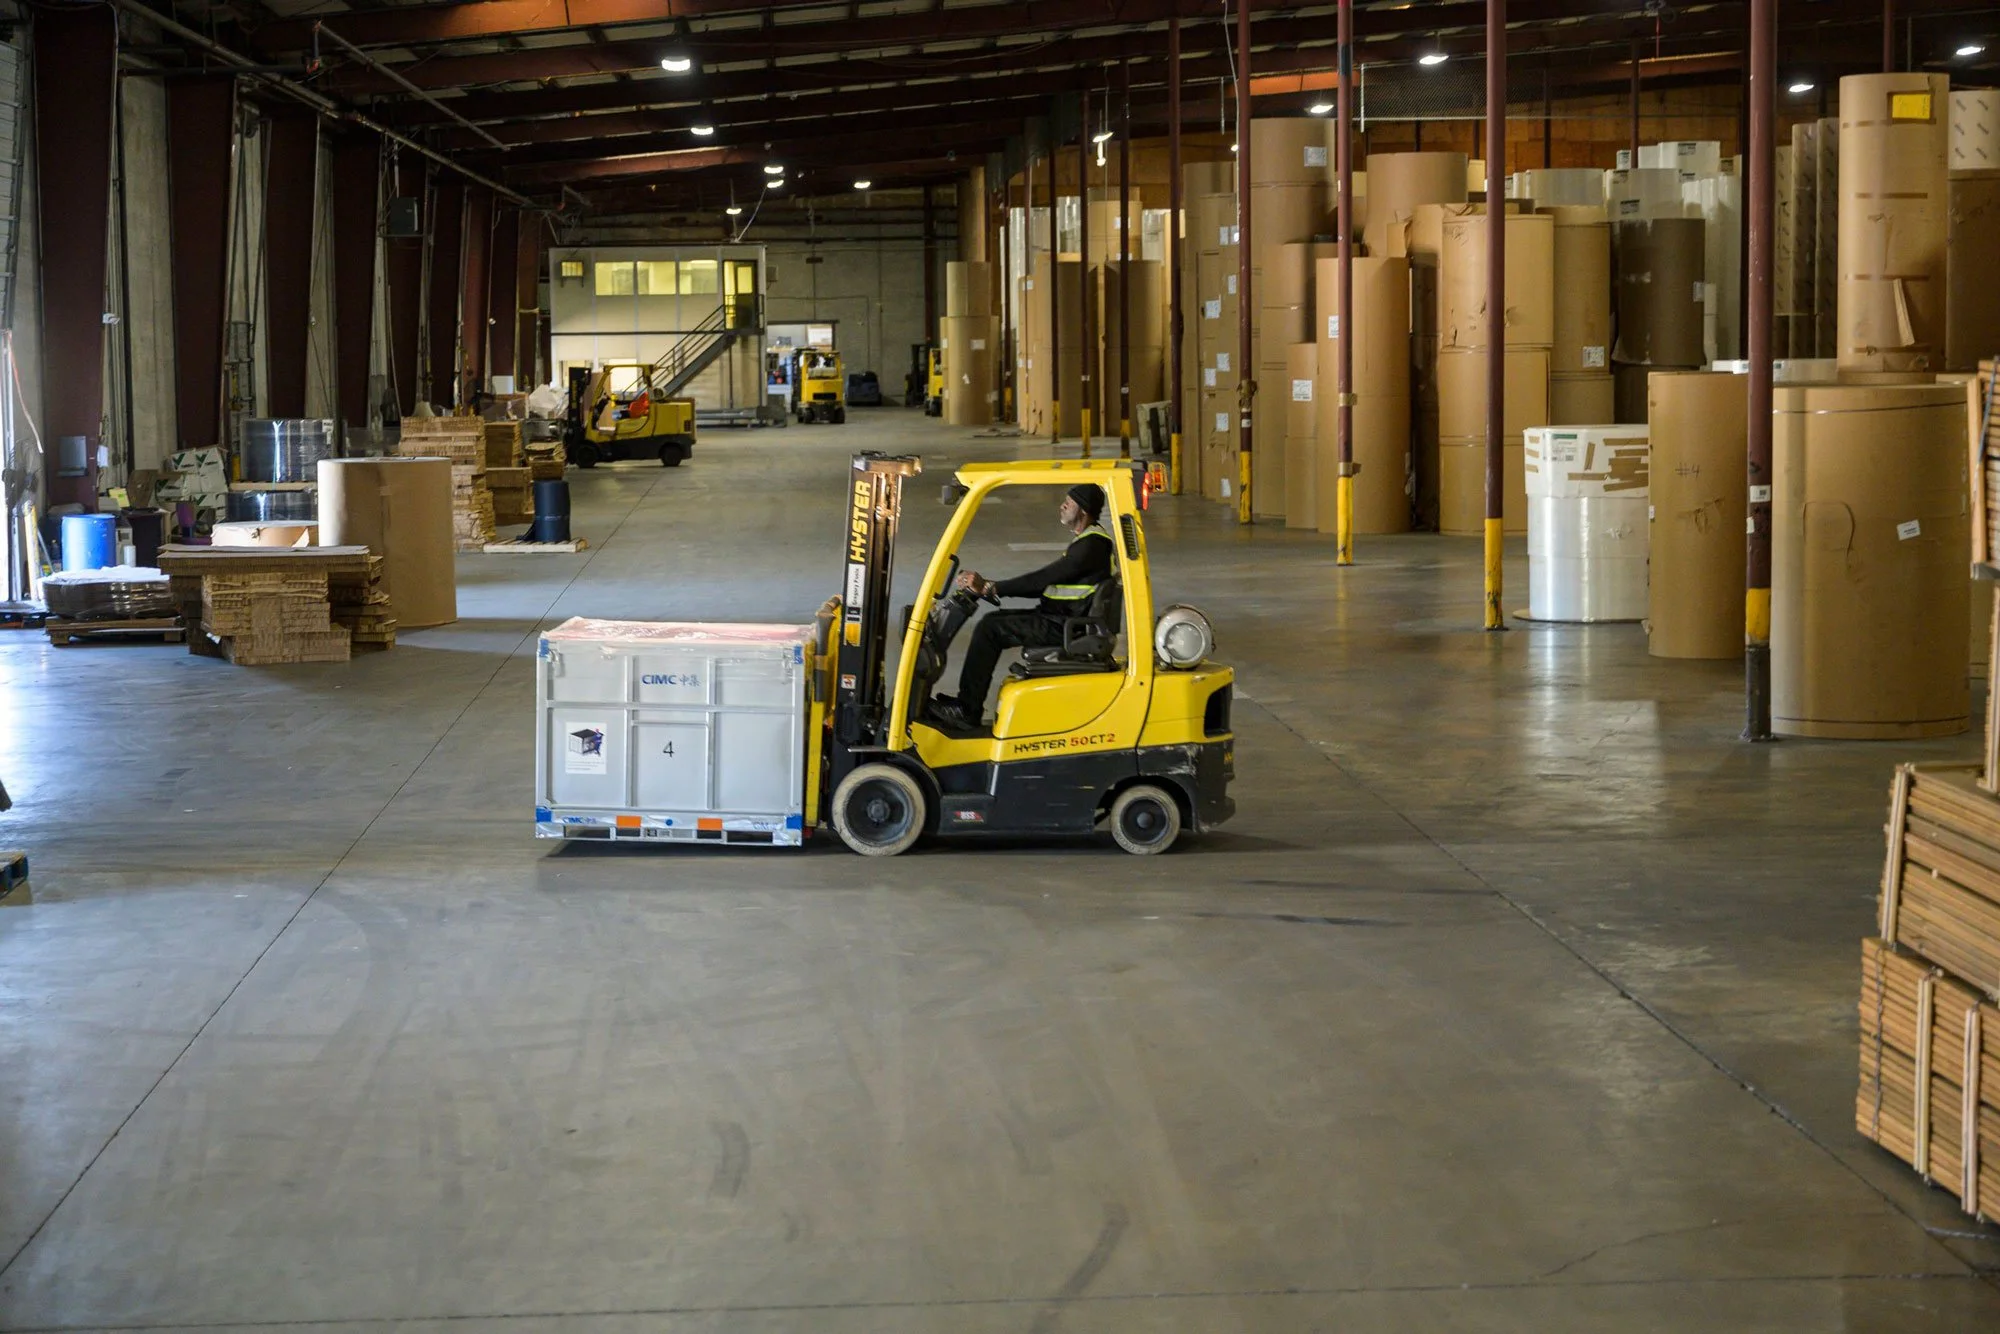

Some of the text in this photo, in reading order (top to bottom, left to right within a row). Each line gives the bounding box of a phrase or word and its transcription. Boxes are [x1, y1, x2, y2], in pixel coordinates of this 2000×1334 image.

[849, 480, 871, 562] HYSTER
[642, 674, 677, 685] CIMC
[663, 740, 675, 758] 4
[1014, 733, 1116, 753] HYSTER 50CT2
